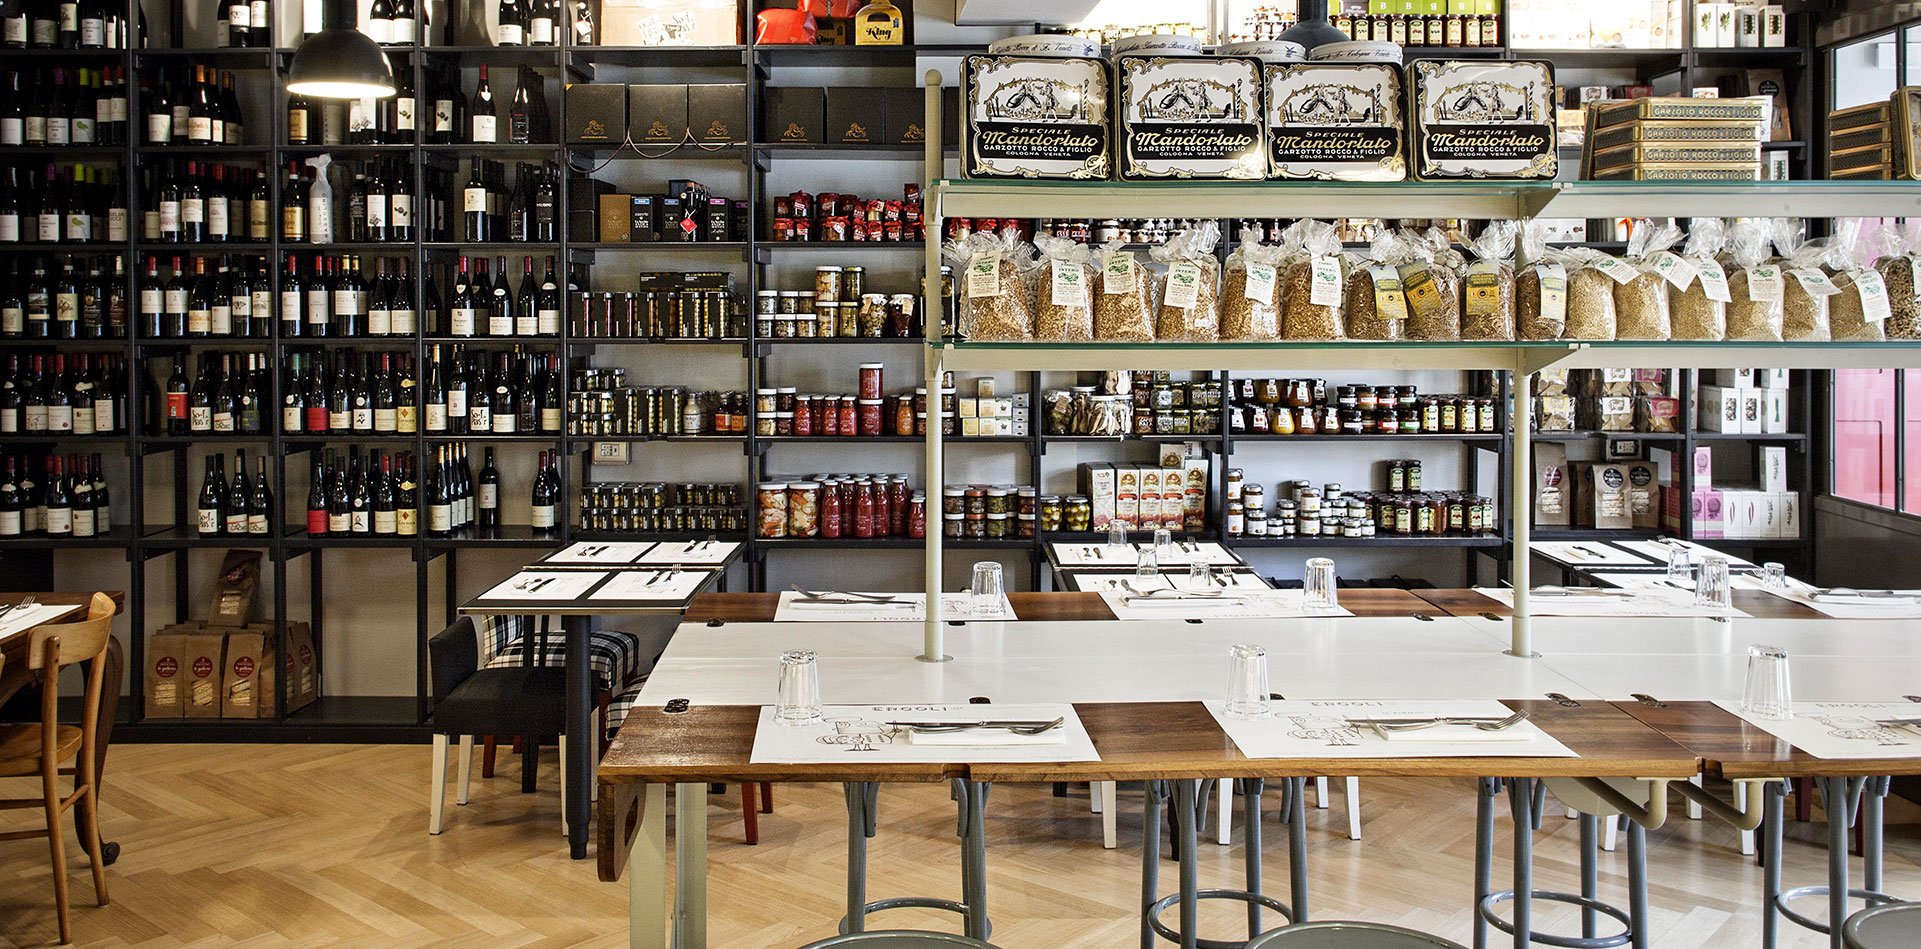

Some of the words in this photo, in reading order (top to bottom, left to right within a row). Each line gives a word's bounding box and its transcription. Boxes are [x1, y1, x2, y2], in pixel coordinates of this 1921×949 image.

[866, 26, 891, 40] King
[1012, 127, 1071, 135] SPECIALE
[982, 131, 1098, 146] Mandorlato
[1135, 132, 1252, 146] Mandorlato
[1277, 135, 1392, 149] Mandorlato
[1431, 133, 1544, 146] Mandorlato
